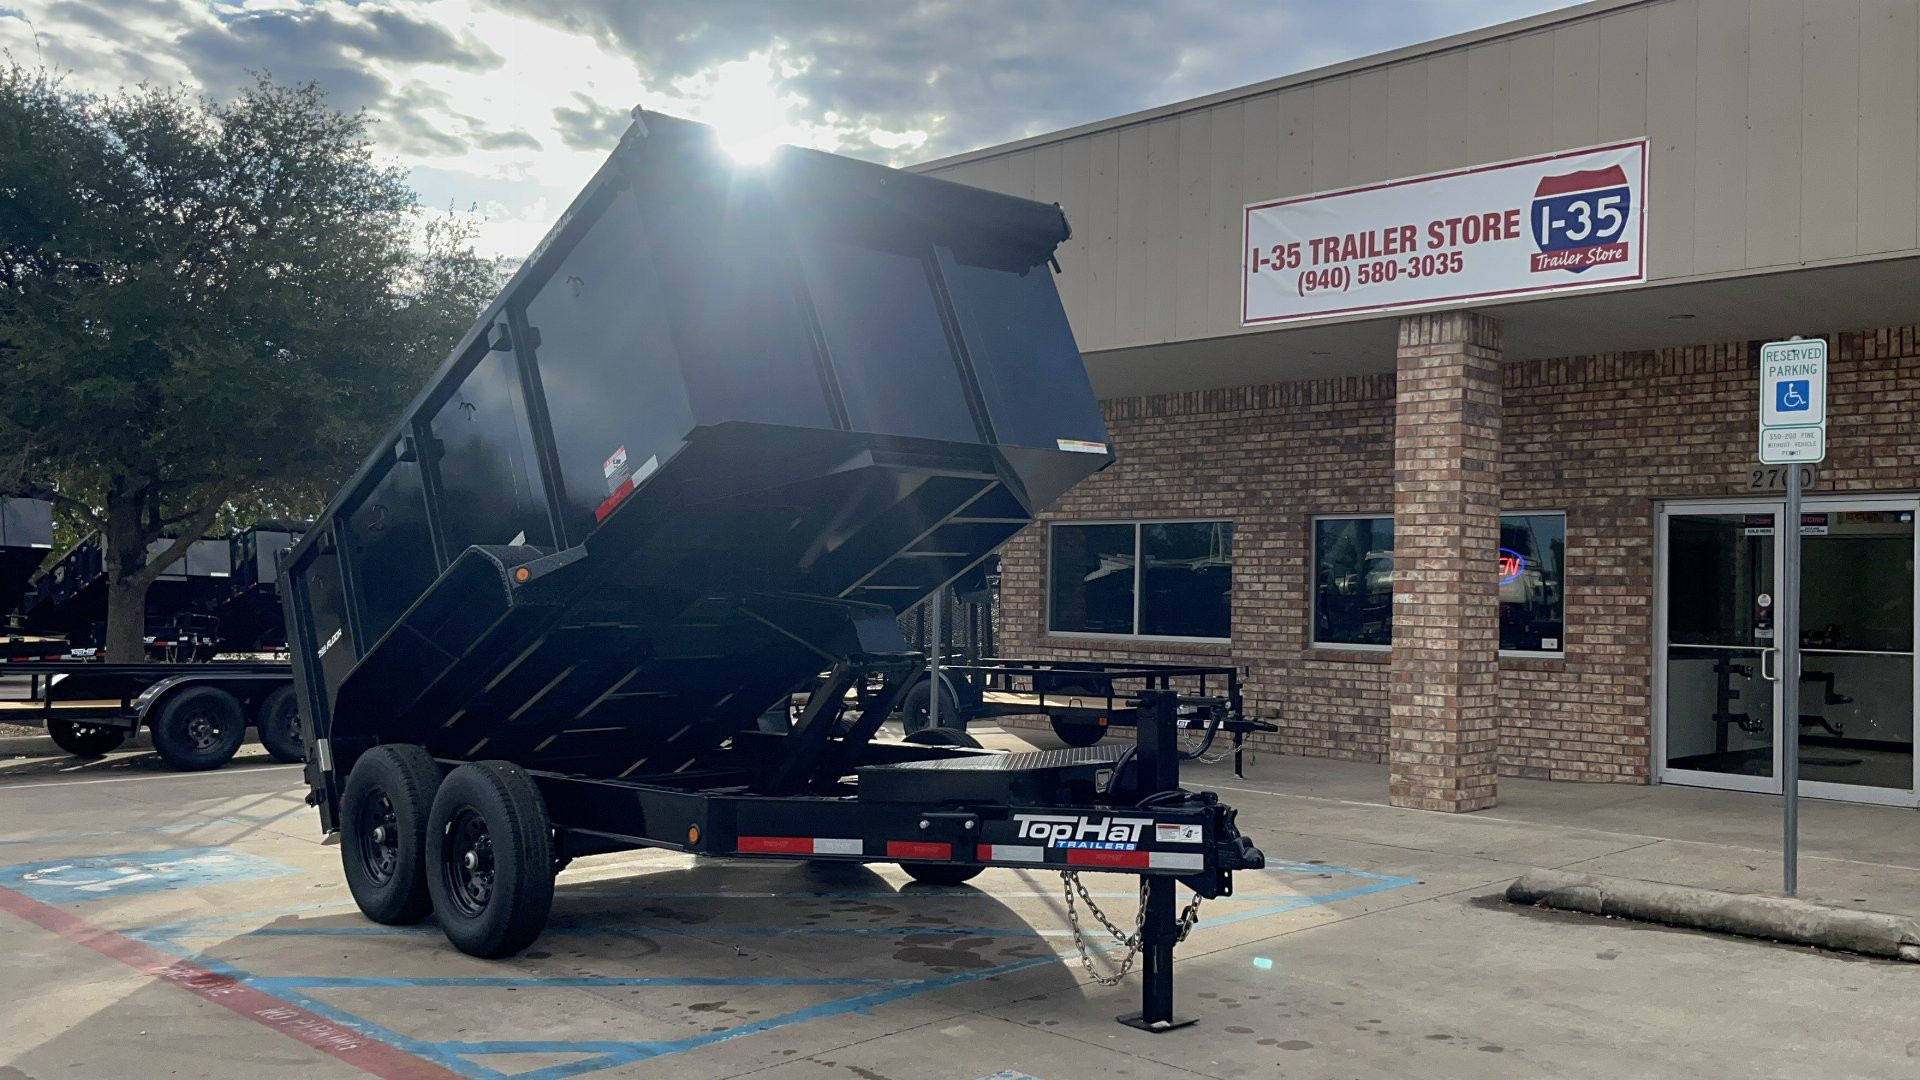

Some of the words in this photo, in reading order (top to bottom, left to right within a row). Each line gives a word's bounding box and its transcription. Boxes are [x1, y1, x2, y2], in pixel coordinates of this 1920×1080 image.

[1542, 195, 1623, 246] I-35
[1252, 242, 1301, 274] I-35
[1309, 224, 1417, 267] TRAILER
[1427, 208, 1521, 250] STORE
[1536, 248, 1582, 271] Trailer
[1585, 245, 1623, 265] Store
[1297, 266, 1351, 297] (940)
[1357, 251, 1464, 286] 580-3035
[1766, 347, 1822, 363] RESERVED
[1769, 363, 1817, 378] PARKING
[1800, 431, 1816, 439] FINE
[1794, 440, 1817, 448] VEHICLE
[1057, 840, 1136, 851] TRAILERS
